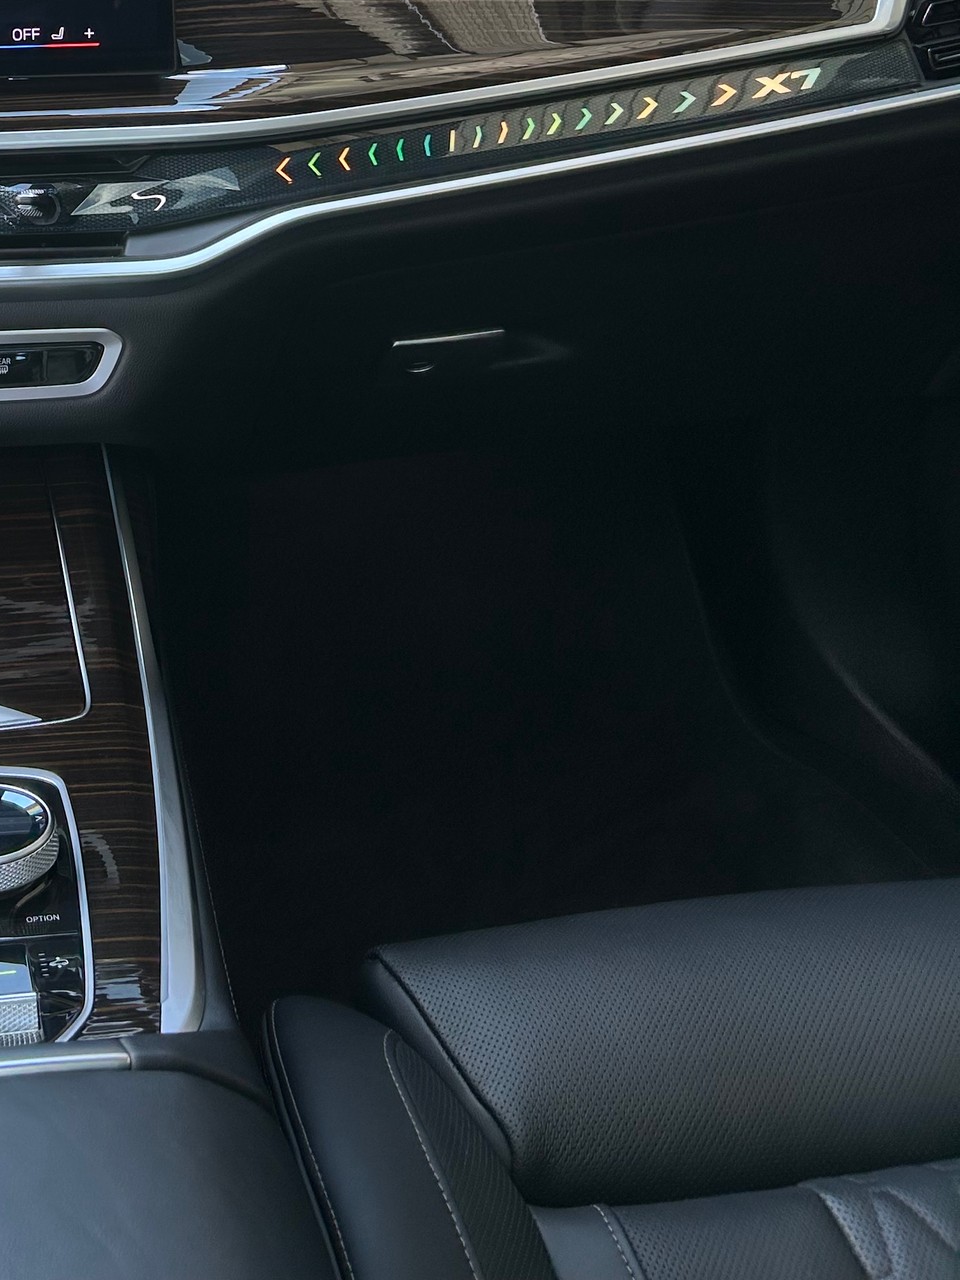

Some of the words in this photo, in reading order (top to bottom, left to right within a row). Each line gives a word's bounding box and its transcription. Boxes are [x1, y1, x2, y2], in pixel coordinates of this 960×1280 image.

[11, 27, 41, 41] OFF
[751, 67, 822, 99] X7
[25, 913, 60, 924] OPTION
